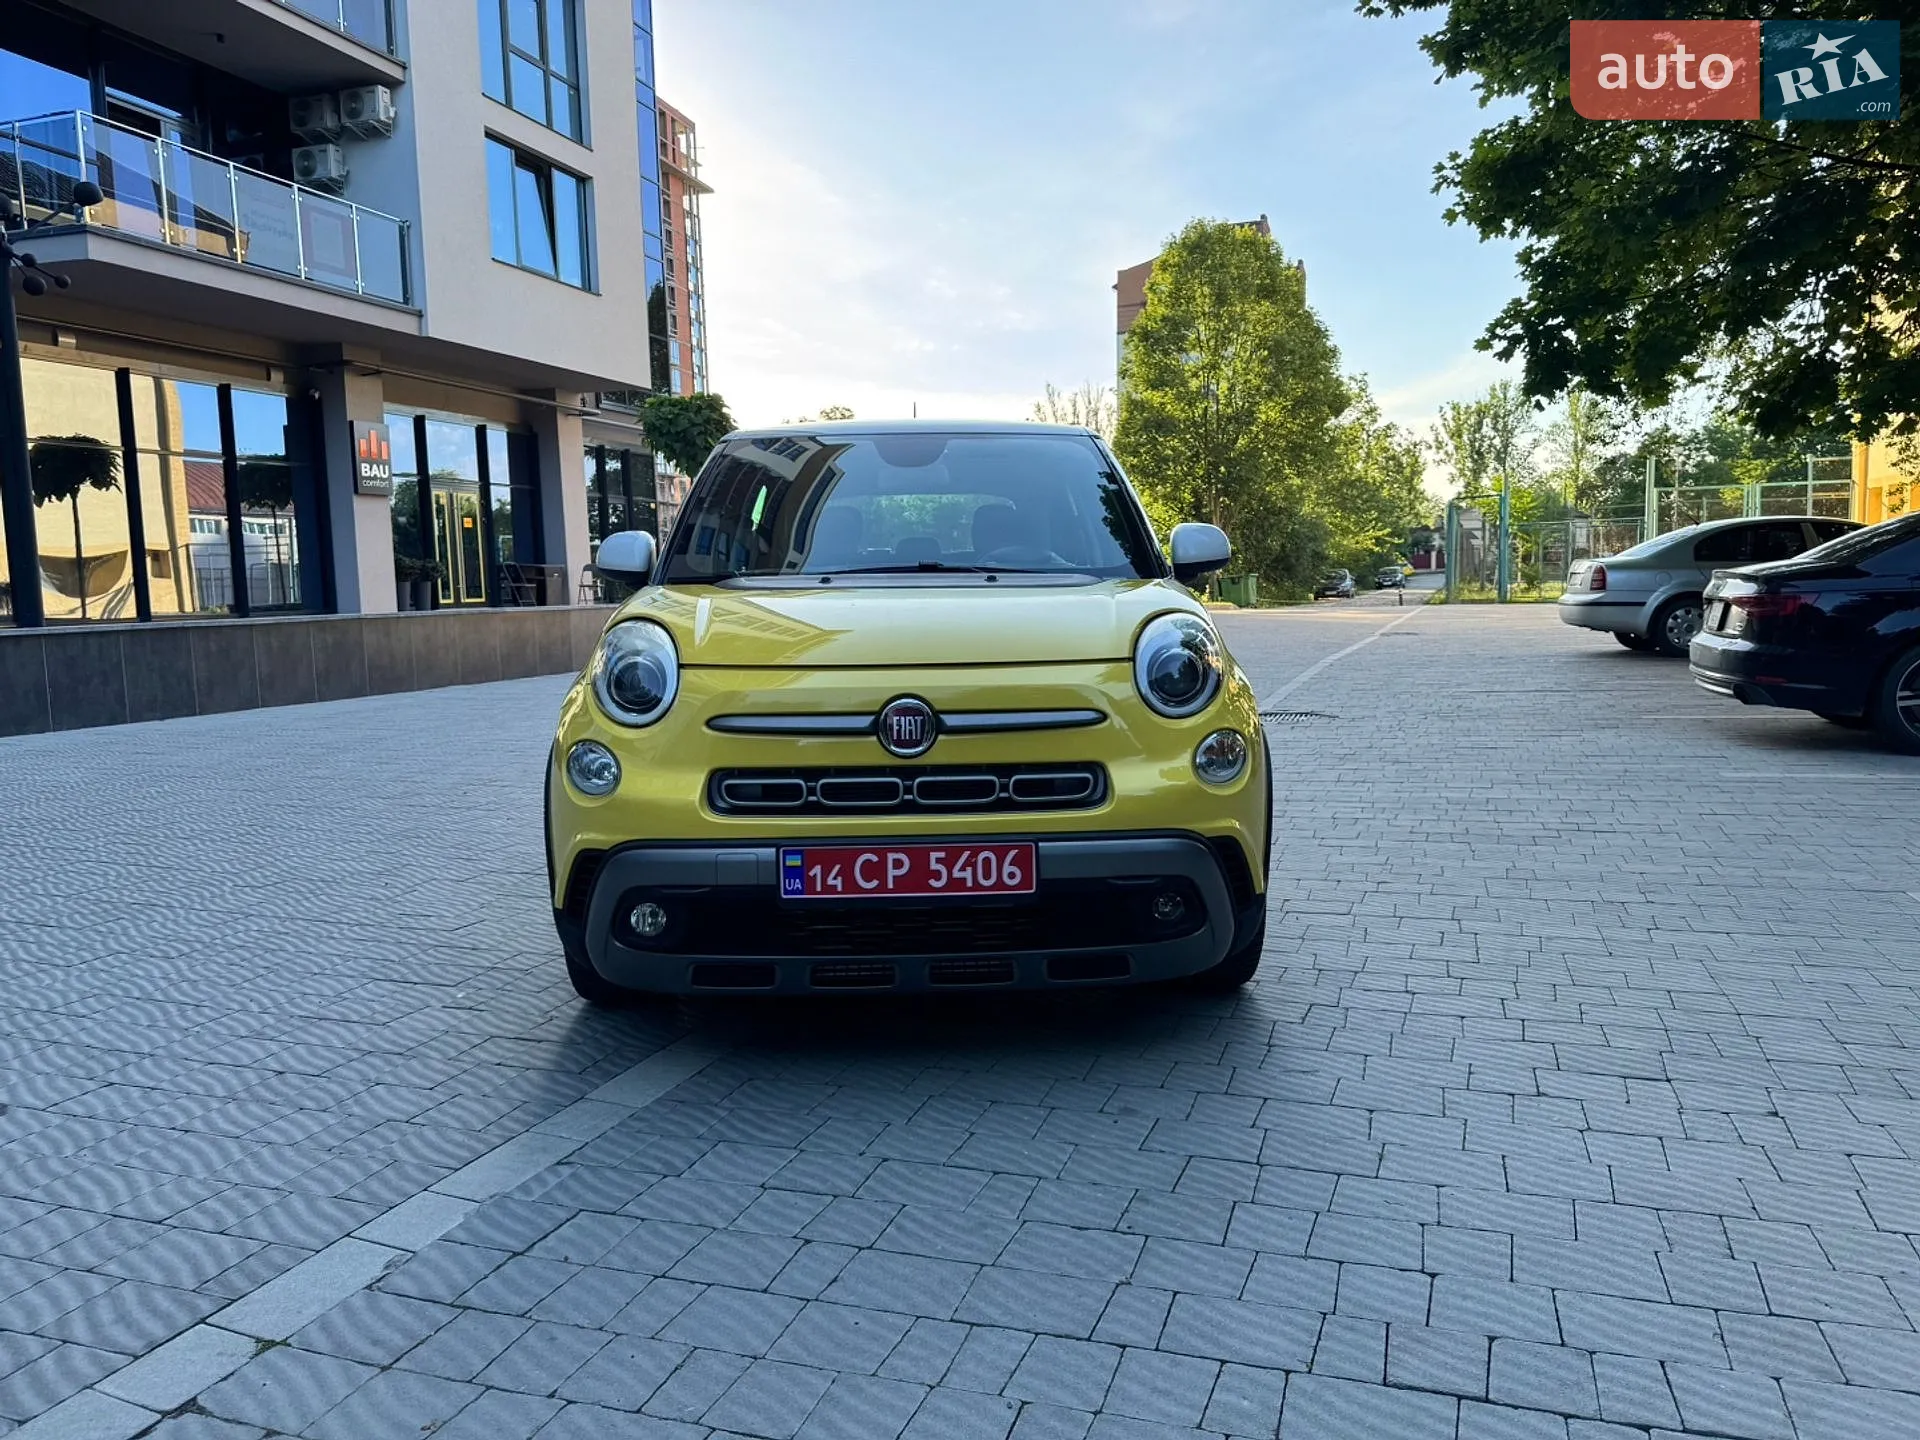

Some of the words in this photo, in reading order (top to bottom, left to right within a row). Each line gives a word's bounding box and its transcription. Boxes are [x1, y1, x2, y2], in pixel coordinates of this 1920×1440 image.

[361, 463, 389, 478] BAU
[893, 715, 923, 740] FIAT
[928, 849, 1022, 888] 5406
[785, 879, 802, 890] UA
